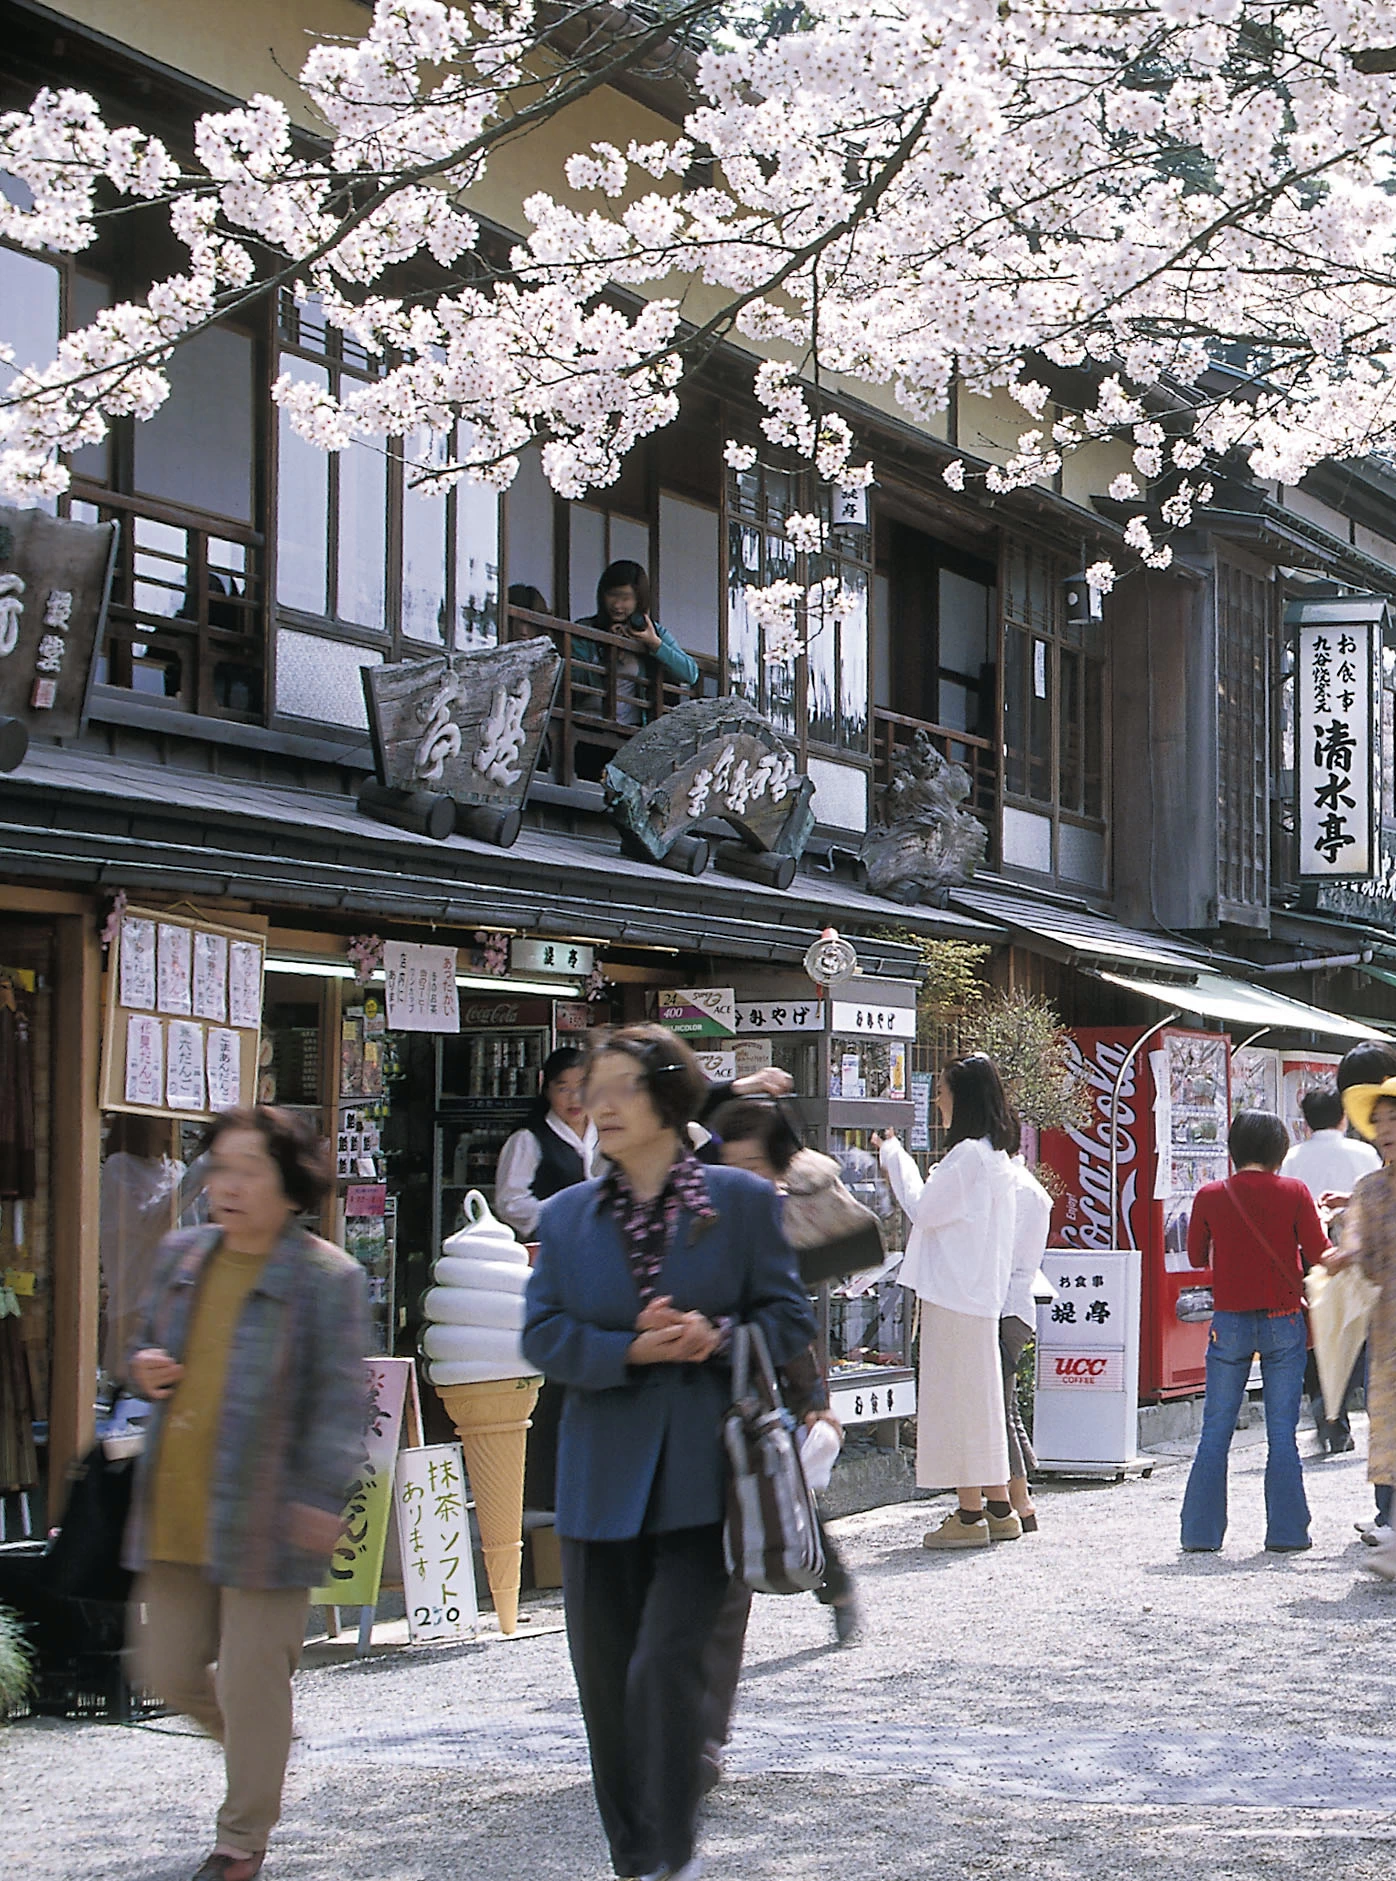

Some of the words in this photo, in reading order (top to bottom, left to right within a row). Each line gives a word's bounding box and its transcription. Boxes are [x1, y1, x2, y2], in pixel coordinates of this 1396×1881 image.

[1337, 633, 1357, 713] お食事
[1314, 719, 1357, 864] 清水亭
[443, 957, 455, 1016] あったかい
[664, 993, 677, 1005] 24
[713, 1006, 732, 1014] ACE
[465, 1003, 520, 1024] Coca-Cola
[663, 1008, 683, 1019] 400
[856, 1010, 896, 1030] おみやげ
[714, 1068, 733, 1077] ACE
[1066, 1192, 1078, 1221] Enjoy!
[1059, 1275, 1104, 1289] お食事
[1051, 1300, 1111, 1324] 堤亭
[1055, 1358, 1107, 1376] UCC
[855, 1389, 893, 1415] お食事
[402, 1481, 428, 1580] あります
[428, 1461, 461, 1604] 抹茶ソフト
